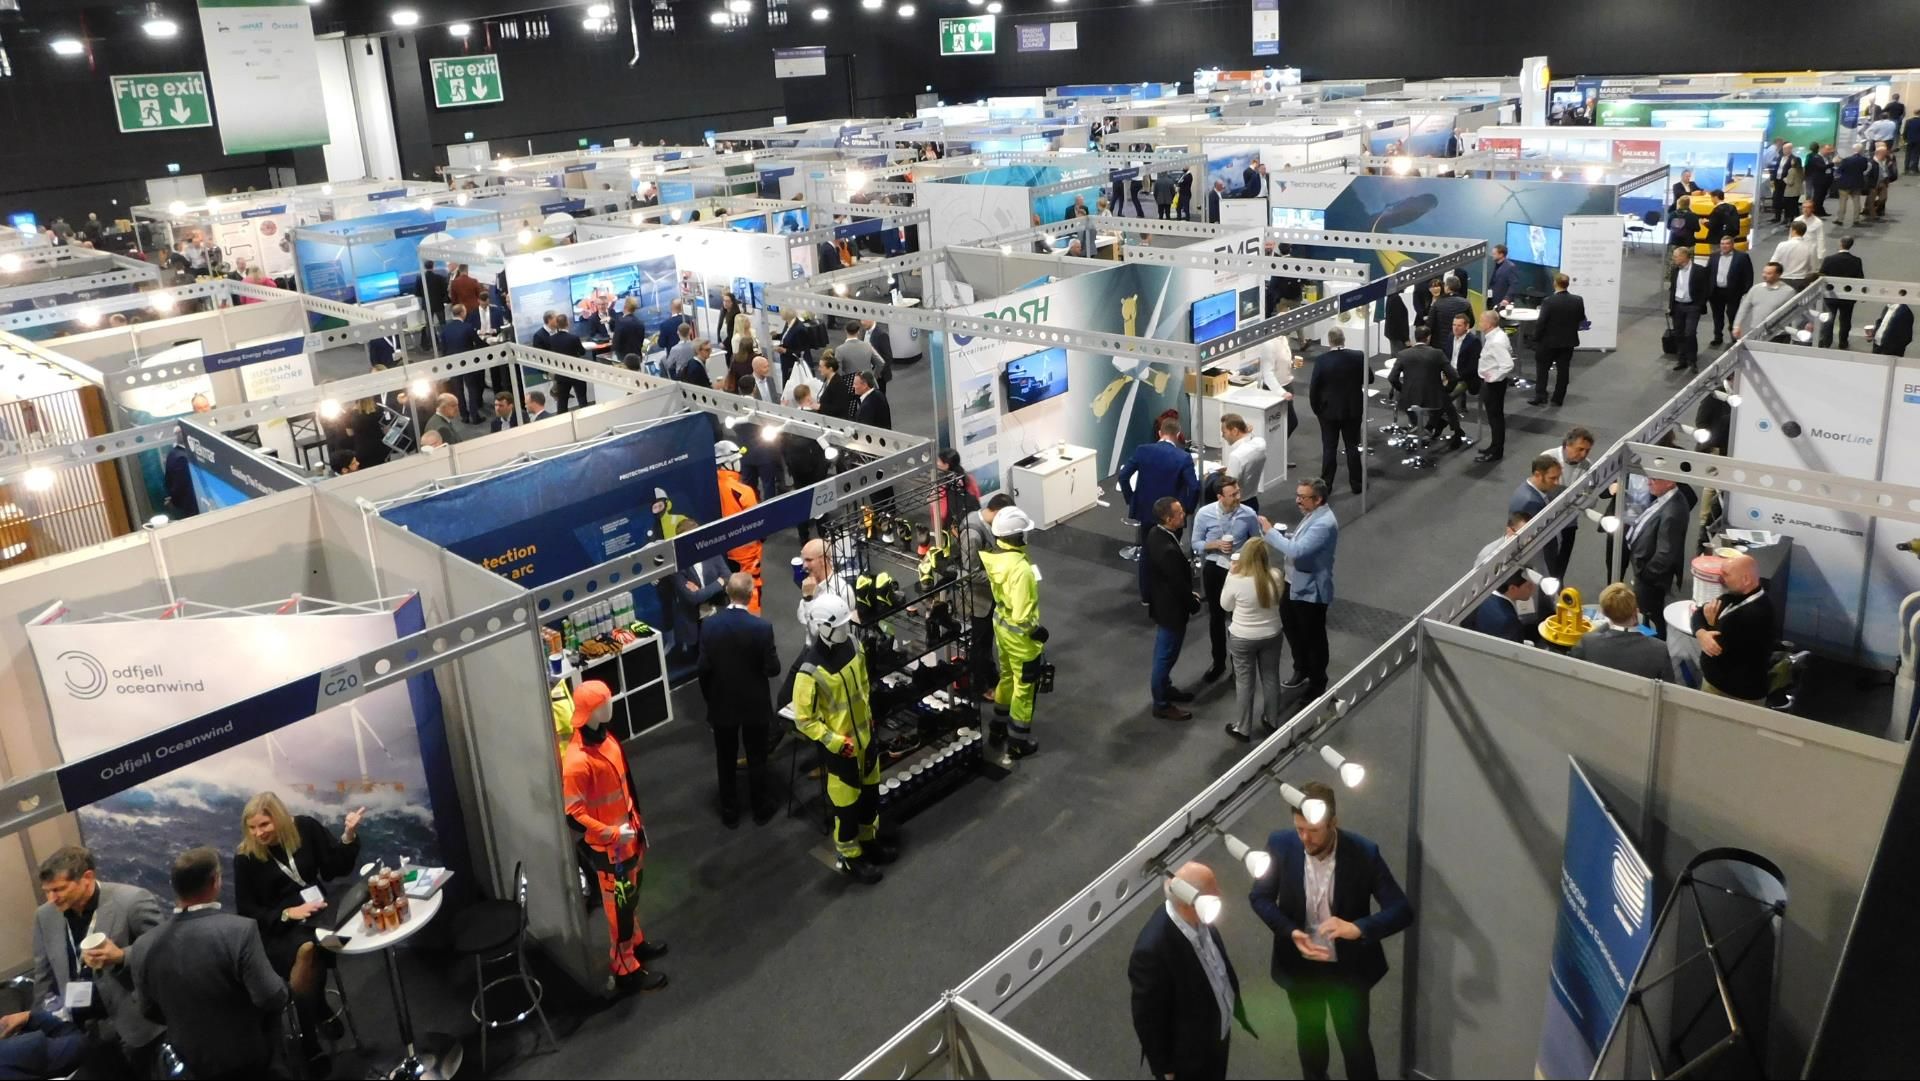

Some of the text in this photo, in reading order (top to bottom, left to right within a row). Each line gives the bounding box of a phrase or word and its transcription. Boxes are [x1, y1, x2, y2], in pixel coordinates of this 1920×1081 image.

[942, 21, 966, 34] Fire
[434, 59, 497, 80] Fire exit
[116, 77, 203, 99] Fire exit
[1290, 180, 1338, 190] TechnipFMC
[958, 342, 996, 358] Excellence
[1810, 427, 1873, 446] MoorLine
[619, 453, 689, 481] PROTECTING PEOPLE AT WORK
[815, 491, 834, 506] C22
[695, 518, 765, 551] Wenaas workwear
[1789, 519, 1832, 532] APPLIED
[511, 563, 535, 580] arc
[112, 664, 164, 685] odfjell
[116, 680, 205, 694] oceanwind
[325, 674, 358, 696] C20
[100, 720, 234, 781] Odfjell Oceanwind
